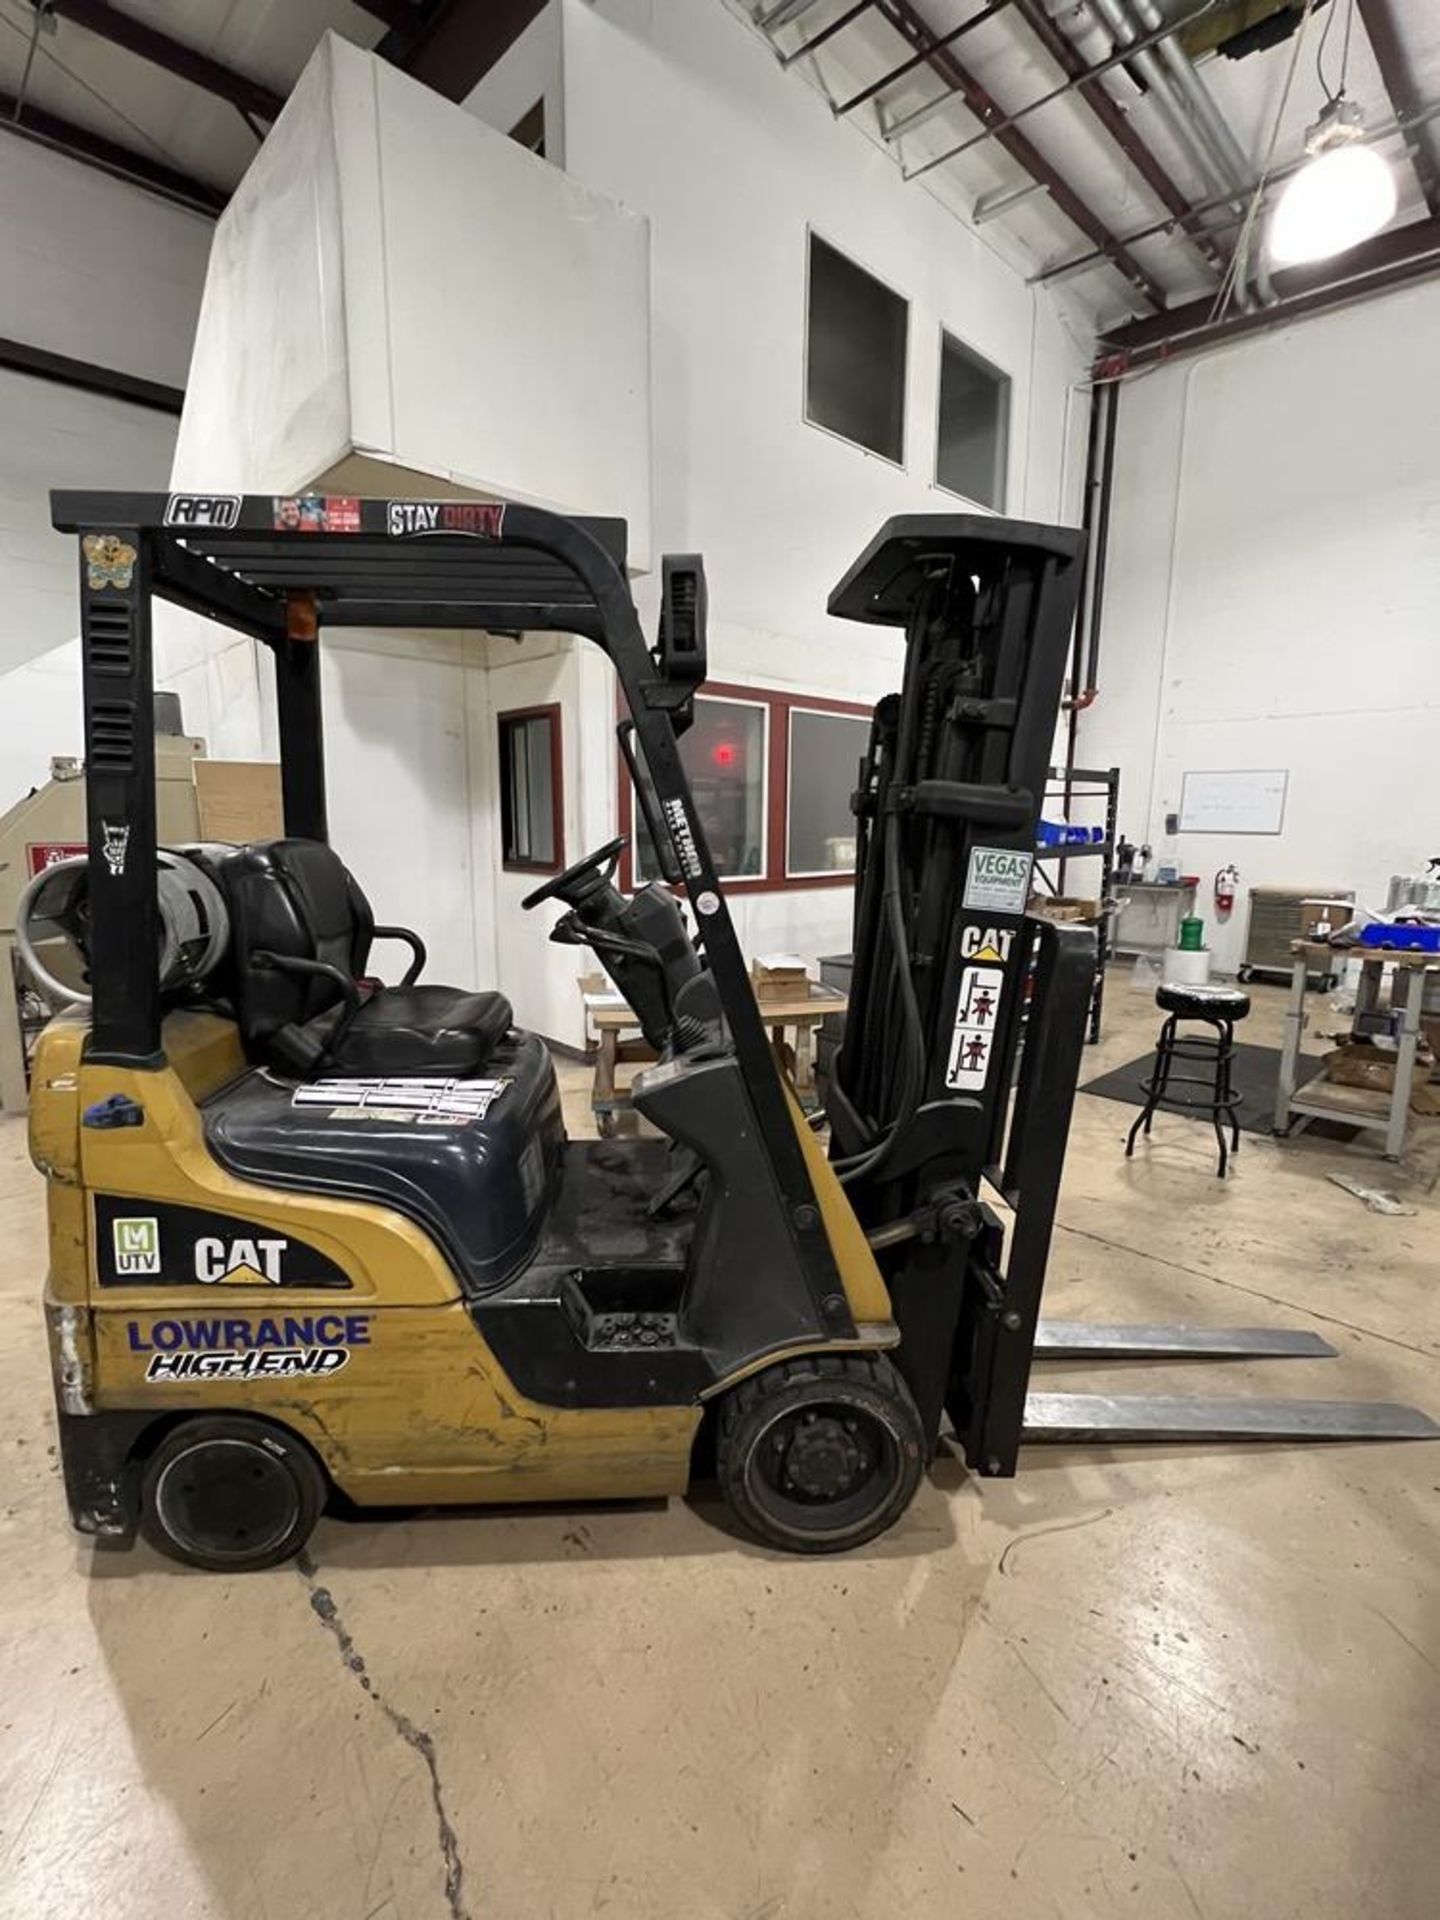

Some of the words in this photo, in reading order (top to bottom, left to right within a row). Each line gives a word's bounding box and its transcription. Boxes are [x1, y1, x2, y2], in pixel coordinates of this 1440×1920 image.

[171, 499, 236, 524] RPM
[391, 504, 439, 536] STAY
[443, 505, 500, 538] DIRTY
[671, 798, 703, 878] METHOD
[974, 854, 1026, 879] VEGAS
[974, 874, 1022, 888] EQUIPMENT
[961, 926, 1016, 962] CAT
[119, 1253, 155, 1270] UTV
[195, 1237, 287, 1284] CAT
[127, 1315, 372, 1351] LOWRANCE
